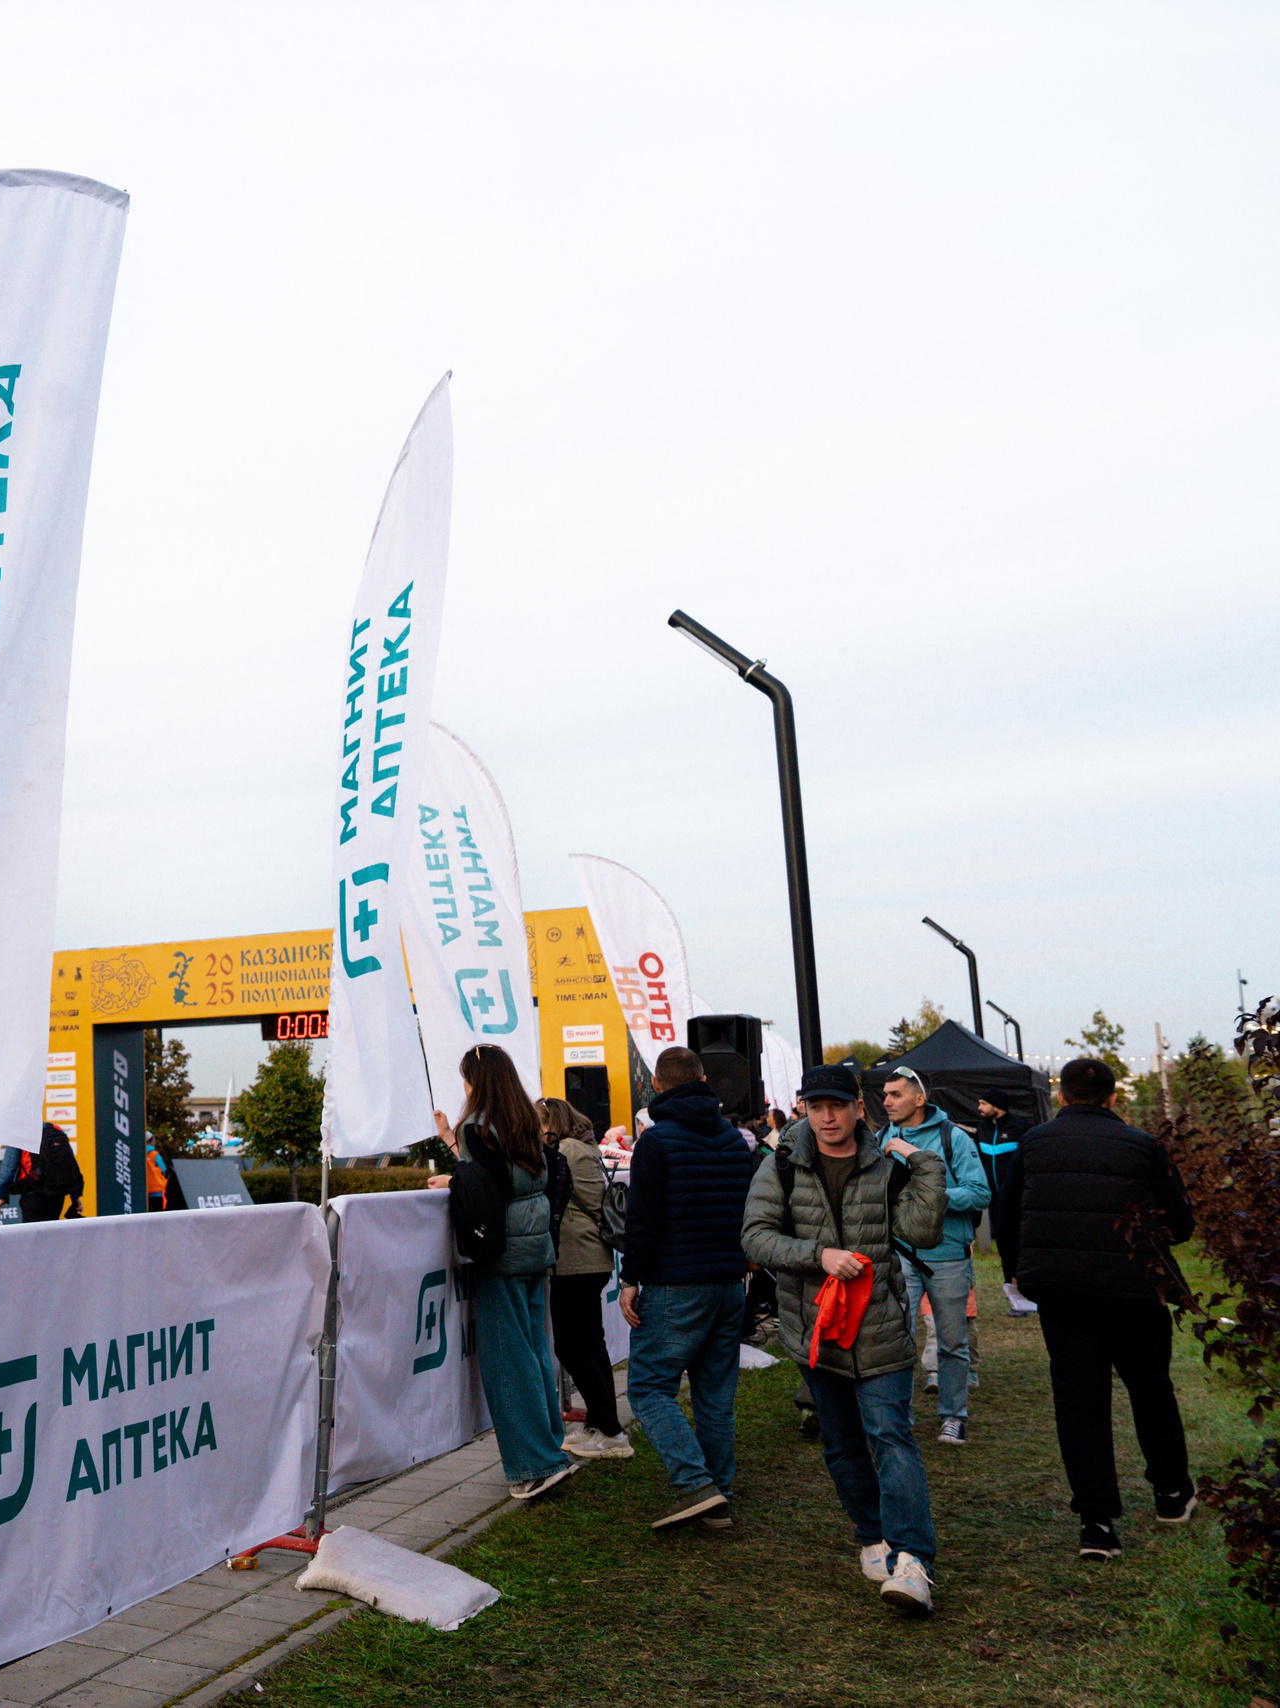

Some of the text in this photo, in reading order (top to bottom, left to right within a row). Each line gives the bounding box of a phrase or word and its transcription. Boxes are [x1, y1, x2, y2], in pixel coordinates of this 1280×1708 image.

[339, 617, 371, 846] МАГНИТ
[371, 579, 414, 818] АПТЕКА
[205, 952, 234, 977] 20
[205, 981, 235, 1006] 25
[240, 943, 333, 967] КАЗАНСК
[277, 1014, 329, 1040] 0:00:
[113, 1049, 130, 1137] 0:59
[122, 1141, 132, 1215] БЫСТРЕ
[62, 1318, 215, 1407] МАГНИТ
[66, 1401, 218, 1502] АПТЕКА
